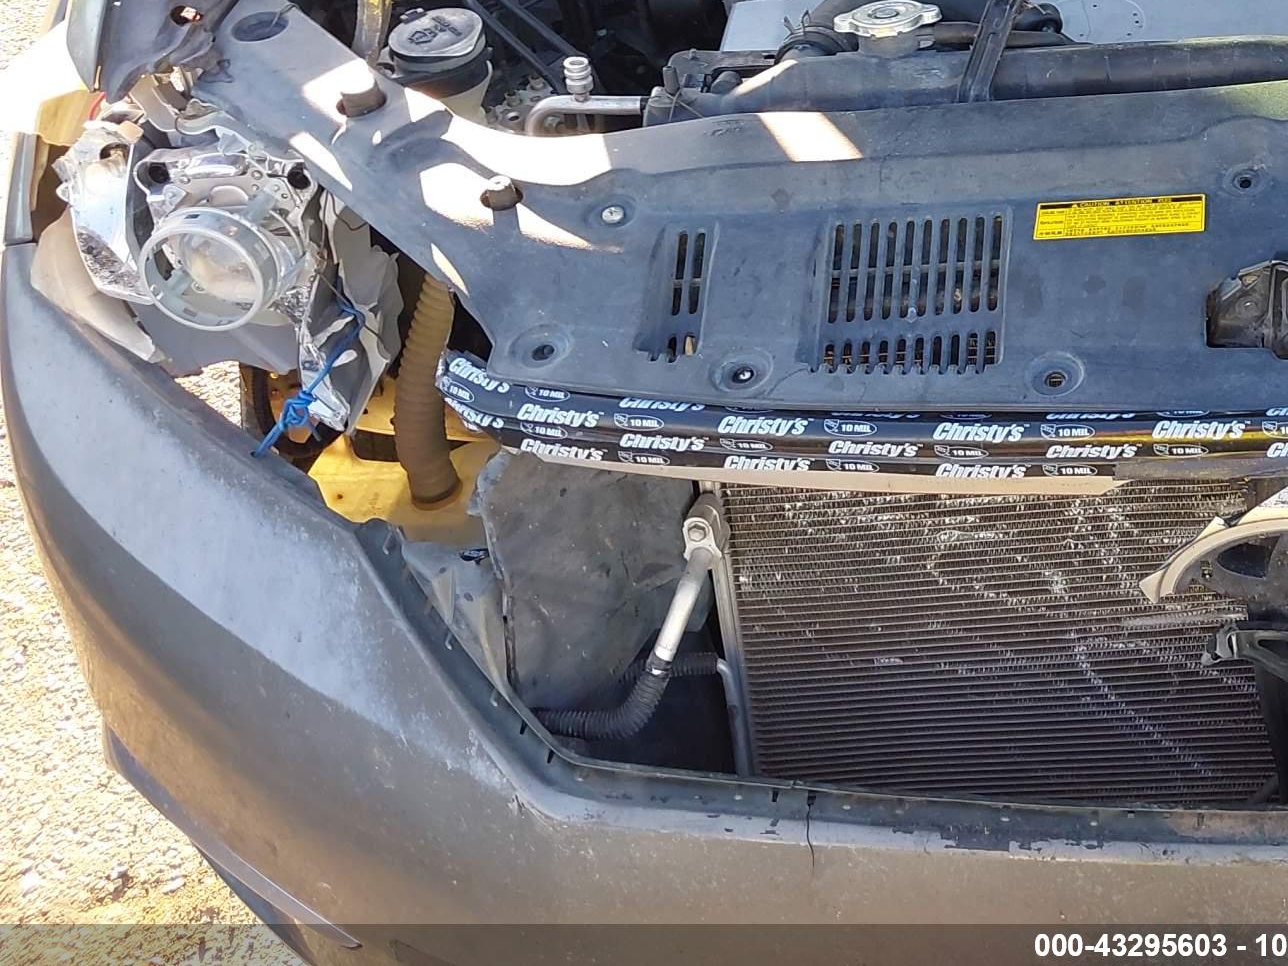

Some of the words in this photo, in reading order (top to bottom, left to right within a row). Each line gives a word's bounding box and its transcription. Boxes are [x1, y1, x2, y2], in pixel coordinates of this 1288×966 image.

[449, 357, 510, 393] Christys
[538, 388, 549, 397] 10
[516, 404, 600, 428] Christy's
[630, 419, 642, 427] 10
[642, 419, 659, 428] MIL
[534, 426, 545, 434] 10
[717, 415, 808, 436] Christy's
[841, 424, 852, 432] 10
[852, 424, 871, 433] MIL
[932, 422, 1025, 443] Christy's
[1057, 428, 1070, 436] 10
[1070, 428, 1089, 437] MIL
[1153, 420, 1246, 440] Christy's
[520, 438, 603, 461] Christy's
[619, 434, 705, 452] Christy's
[828, 440, 920, 457] Christy's
[1045, 443, 1137, 459] Christy's
[855, 463, 873, 471] MIL
[1060, 466, 1073, 474] 10
[1073, 467, 1091, 475] MIL
